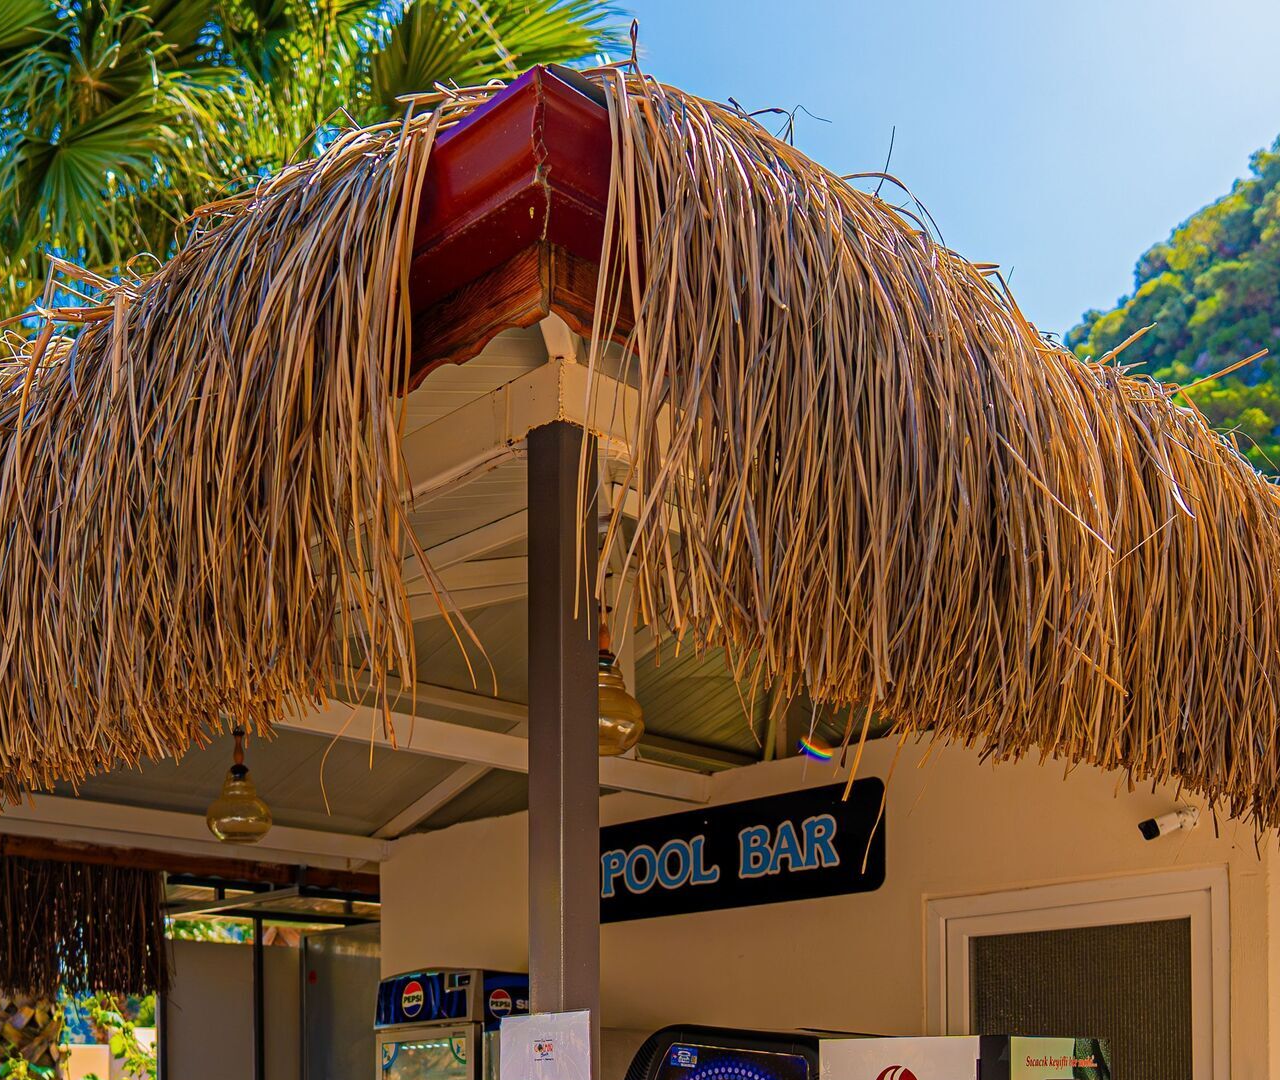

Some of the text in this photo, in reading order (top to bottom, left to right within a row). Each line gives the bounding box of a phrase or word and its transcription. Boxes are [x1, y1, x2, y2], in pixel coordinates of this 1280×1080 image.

[601, 814, 840, 898] POOL BAR
[403, 994, 422, 1004] PEPSI
